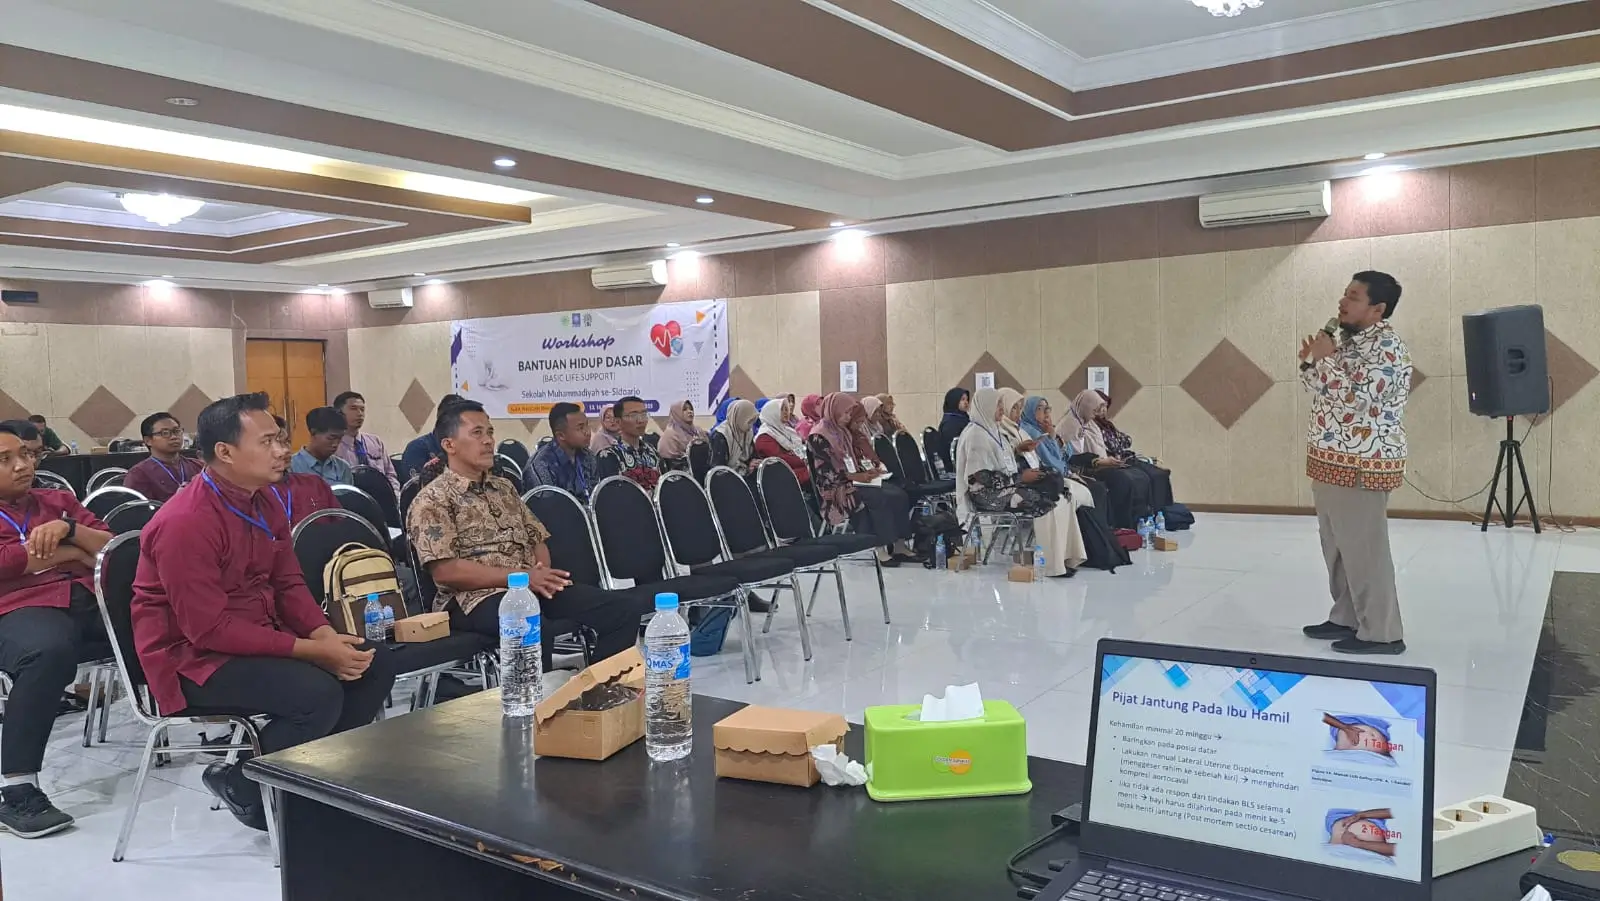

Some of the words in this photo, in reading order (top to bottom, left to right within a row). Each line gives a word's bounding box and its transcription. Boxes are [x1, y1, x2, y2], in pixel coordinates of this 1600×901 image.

[542, 333, 615, 350] Workshop
[518, 360, 567, 372] BANTUAN
[569, 357, 603, 369] HIDUP
[605, 355, 643, 367] DASAR
[565, 373, 580, 382] LIFE
[521, 390, 546, 399] Sekolah
[547, 388, 600, 399] Muhammadiyah
[601, 386, 641, 397] se-Sidoarjo
[1112, 691, 1138, 705] Pijat
[1141, 696, 1188, 714] Jantung
[1192, 701, 1223, 716] Pada
[1227, 706, 1247, 718] Ibu
[1252, 709, 1290, 724] Hamil
[1109, 720, 1144, 731] Kehamilan
[1145, 725, 1174, 735] minimal
[1175, 728, 1184, 736] 20
[1185, 730, 1213, 741] minggu
[1122, 735, 1156, 746] Baringkan
[1157, 740, 1175, 750] pada
[1176, 744, 1197, 753] posisi
[1198, 746, 1217, 755] datar
[1371, 738, 1404, 752] Tangan
[1121, 747, 1149, 757] Lakukan
[1151, 751, 1177, 762] manual
[1178, 756, 1202, 766] Lateral
[1204, 760, 1231, 771] Uterine
[1233, 764, 1284, 778] Displacement
[1119, 768, 1151, 779] kompresi
[1152, 773, 1189, 785] aortocaval
[1120, 758, 1161, 770] (menggeser
[1162, 765, 1183, 774] rahim
[1184, 767, 1193, 775] ke
[1194, 769, 1223, 781] sebelah
[1224, 774, 1239, 784] kiri)
[1251, 778, 1300, 792] menghindari
[1132, 782, 1150, 791] tidak
[1151, 785, 1164, 793] ada
[1165, 788, 1190, 799] respon
[1191, 791, 1206, 800] dari
[1207, 794, 1240, 806] tindakan
[1241, 800, 1255, 809] BLS
[1256, 802, 1284, 813] selama
[1117, 791, 1138, 800] menit
[1149, 796, 1164, 805] bayi
[1165, 799, 1185, 808] harus
[1186, 802, 1222, 814] dilahirkan
[1224, 808, 1243, 818] pada
[1244, 812, 1267, 822] menit
[1268, 815, 1286, 825] ke-5
[1117, 801, 1134, 810] sejak
[1135, 803, 1154, 813] henti
[1155, 807, 1182, 820] jantung
[1183, 811, 1202, 822] (Post
[1203, 816, 1234, 828] mortem
[1235, 821, 1258, 832] sectio
[1259, 826, 1297, 840] cesarean)
[1361, 824, 1368, 833] 2
[1369, 825, 1402, 840] Tangan
